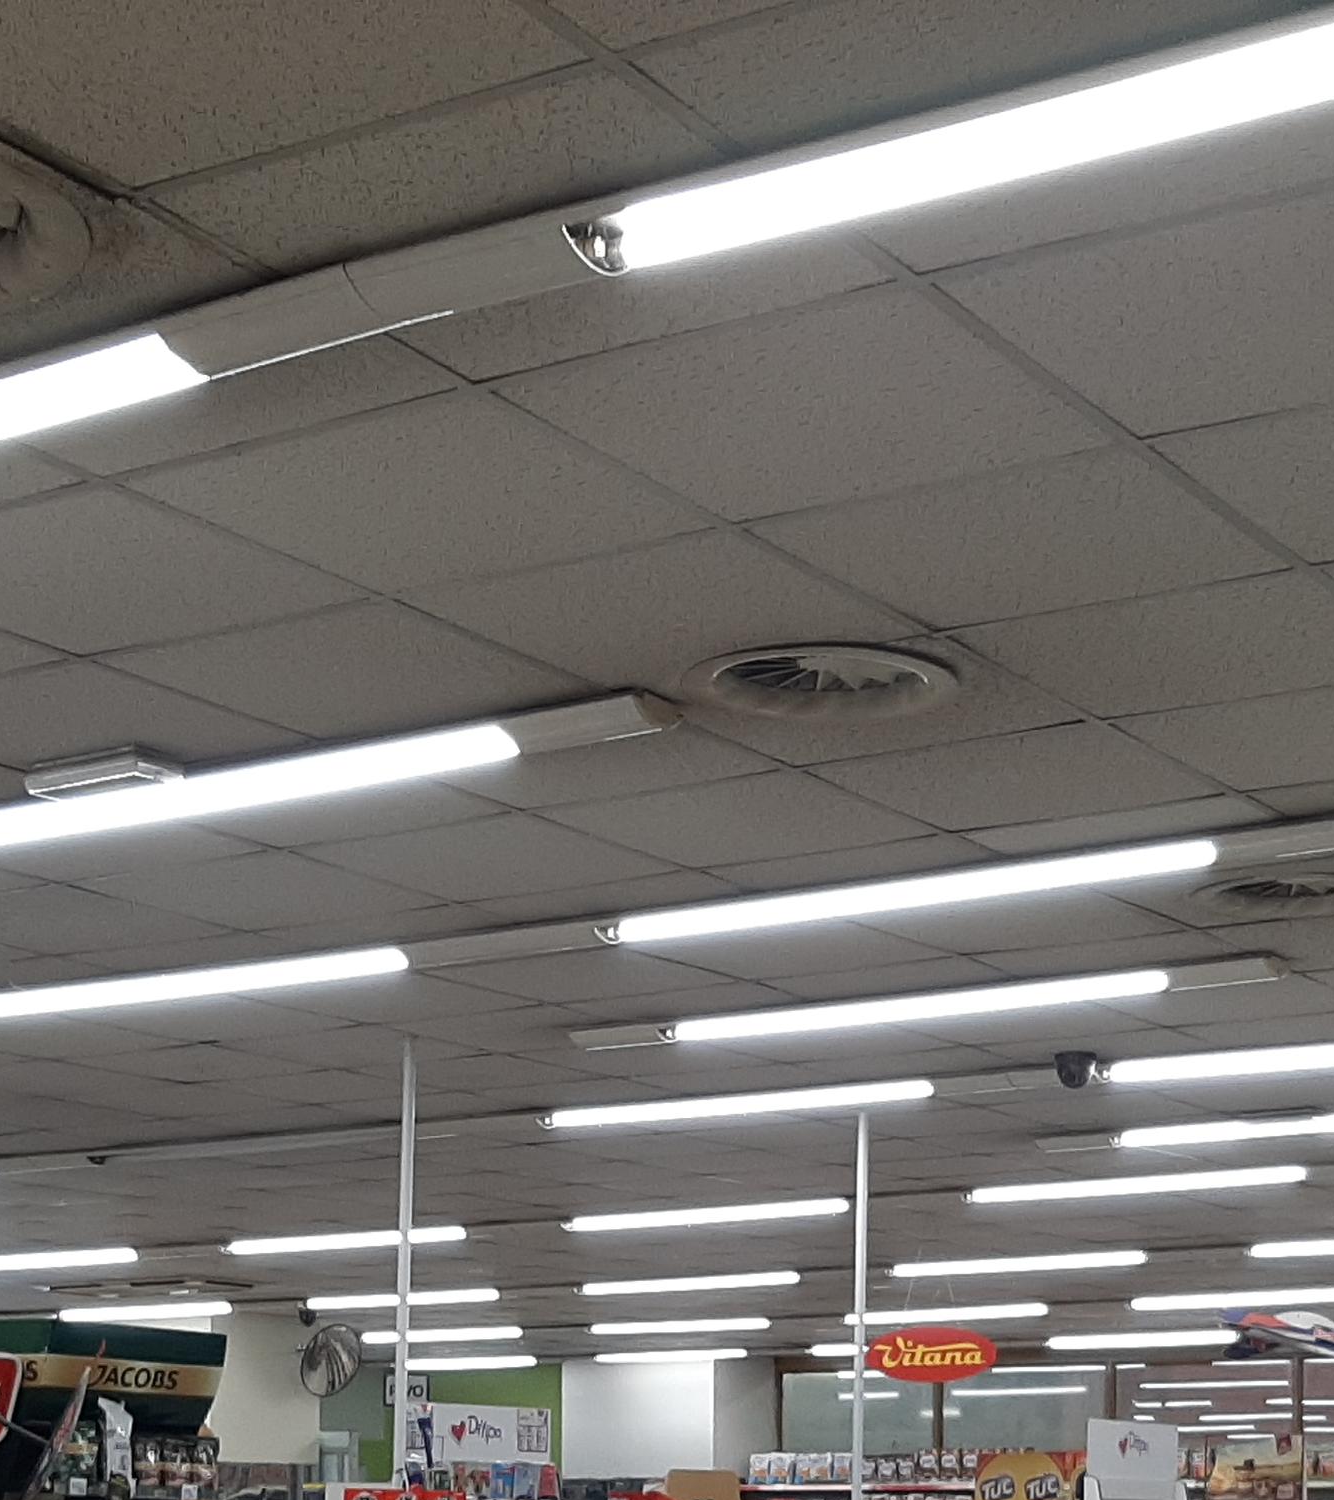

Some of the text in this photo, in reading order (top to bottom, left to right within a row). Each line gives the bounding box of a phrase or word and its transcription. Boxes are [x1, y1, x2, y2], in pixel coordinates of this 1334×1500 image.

[873, 1335, 985, 1369] Vitana
[89, 1364, 179, 1390] JACOBS
[982, 1477, 1014, 1500] TUC
[1026, 1476, 1059, 1500] TUC
